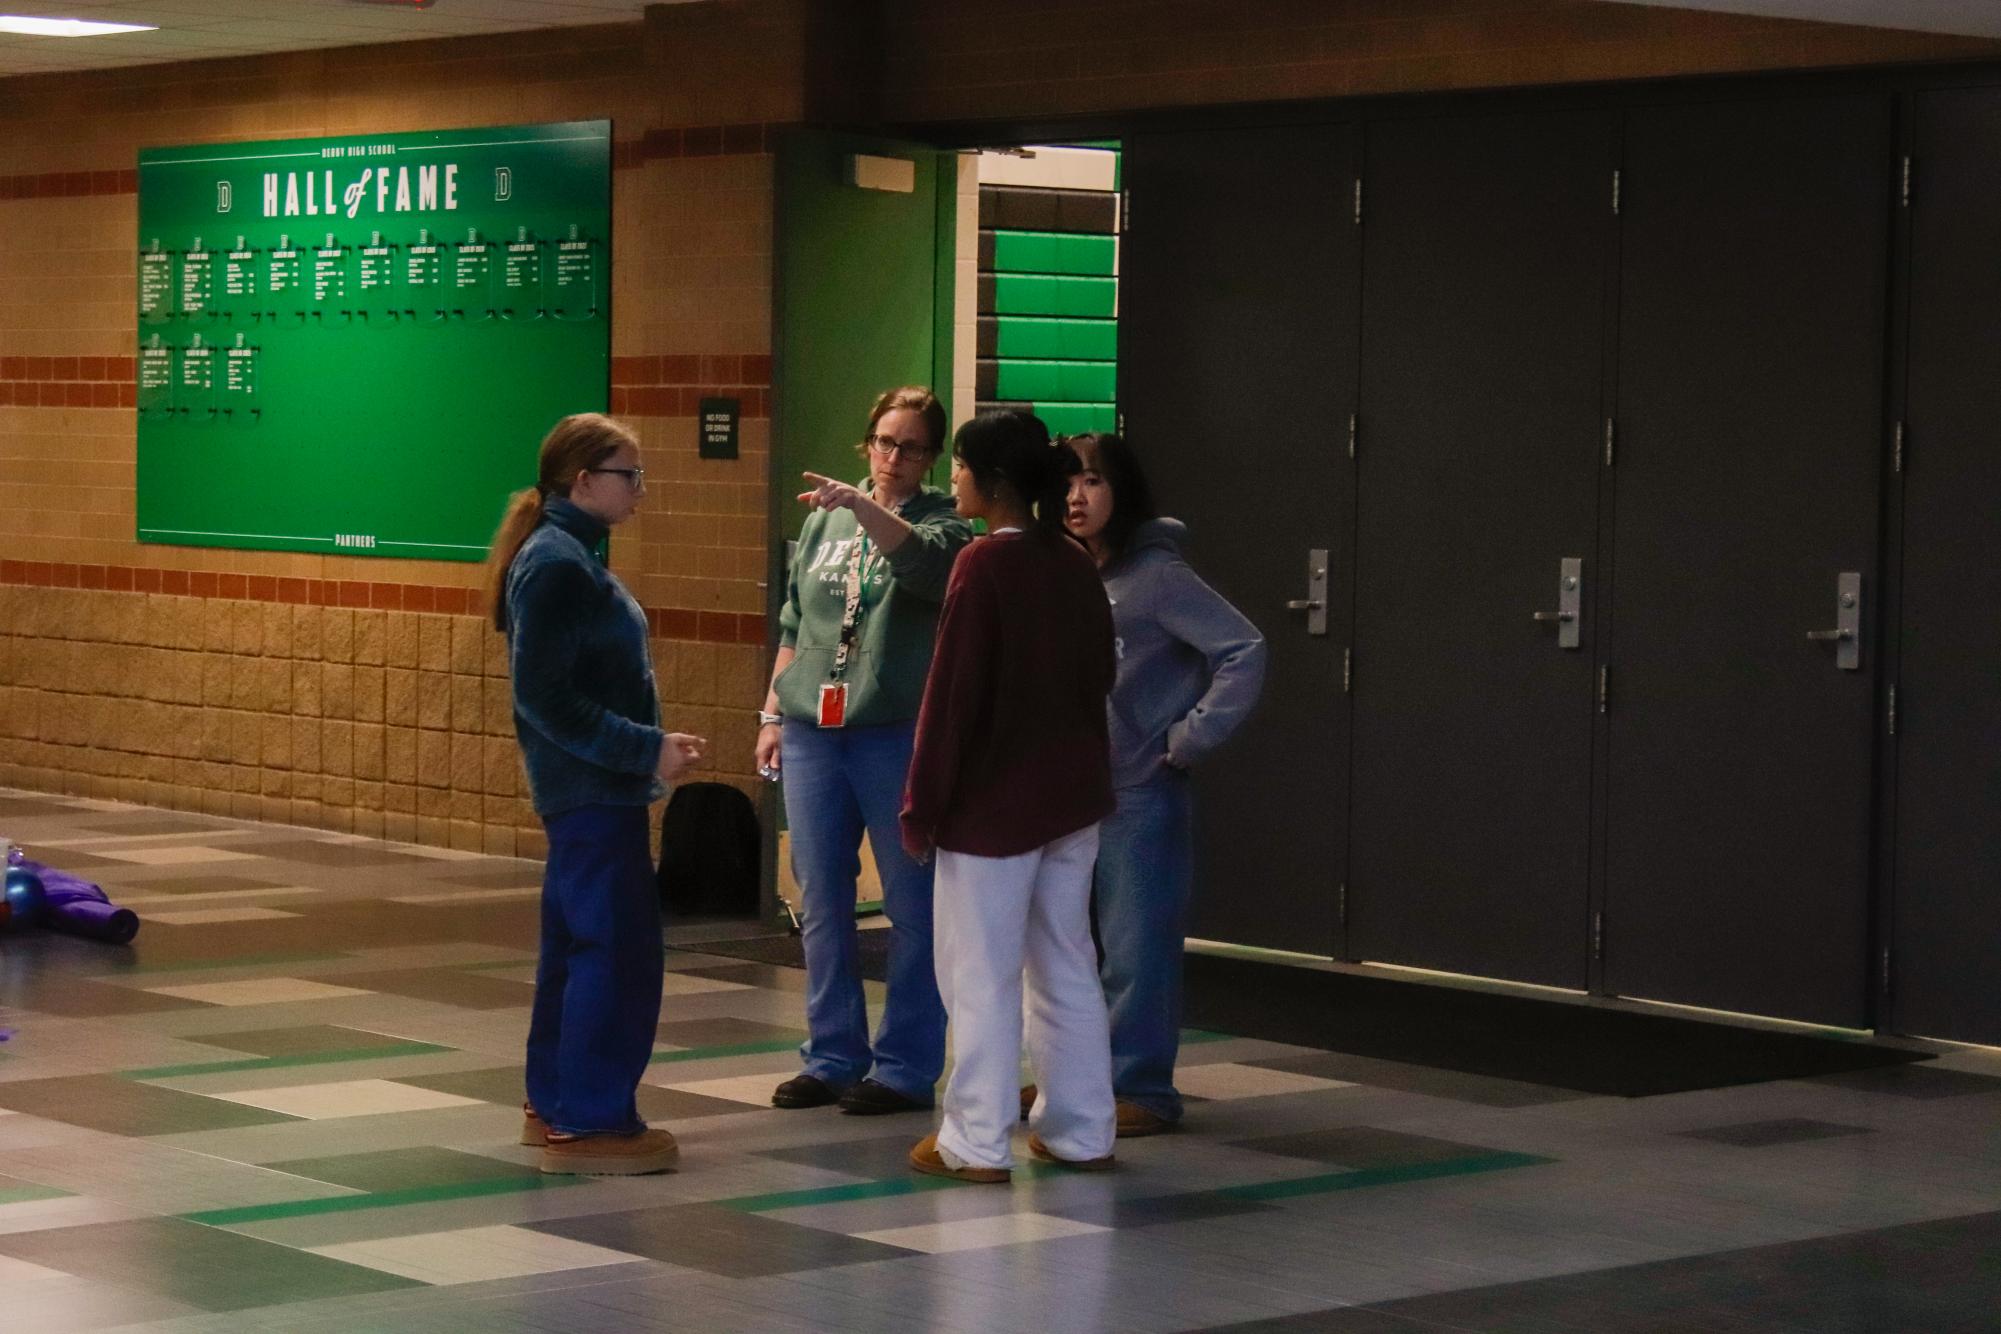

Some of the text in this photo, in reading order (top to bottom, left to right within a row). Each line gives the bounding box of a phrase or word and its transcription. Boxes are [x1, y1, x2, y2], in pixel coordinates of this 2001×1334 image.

[347, 146, 365, 157] HIGH
[368, 144, 396, 155] SCHOOL
[263, 164, 459, 219] HALL of FAME
[706, 414, 730, 422] NO FOOD
[705, 424, 731, 432] OR DRINK
[335, 534, 375, 548] PANTHERS
